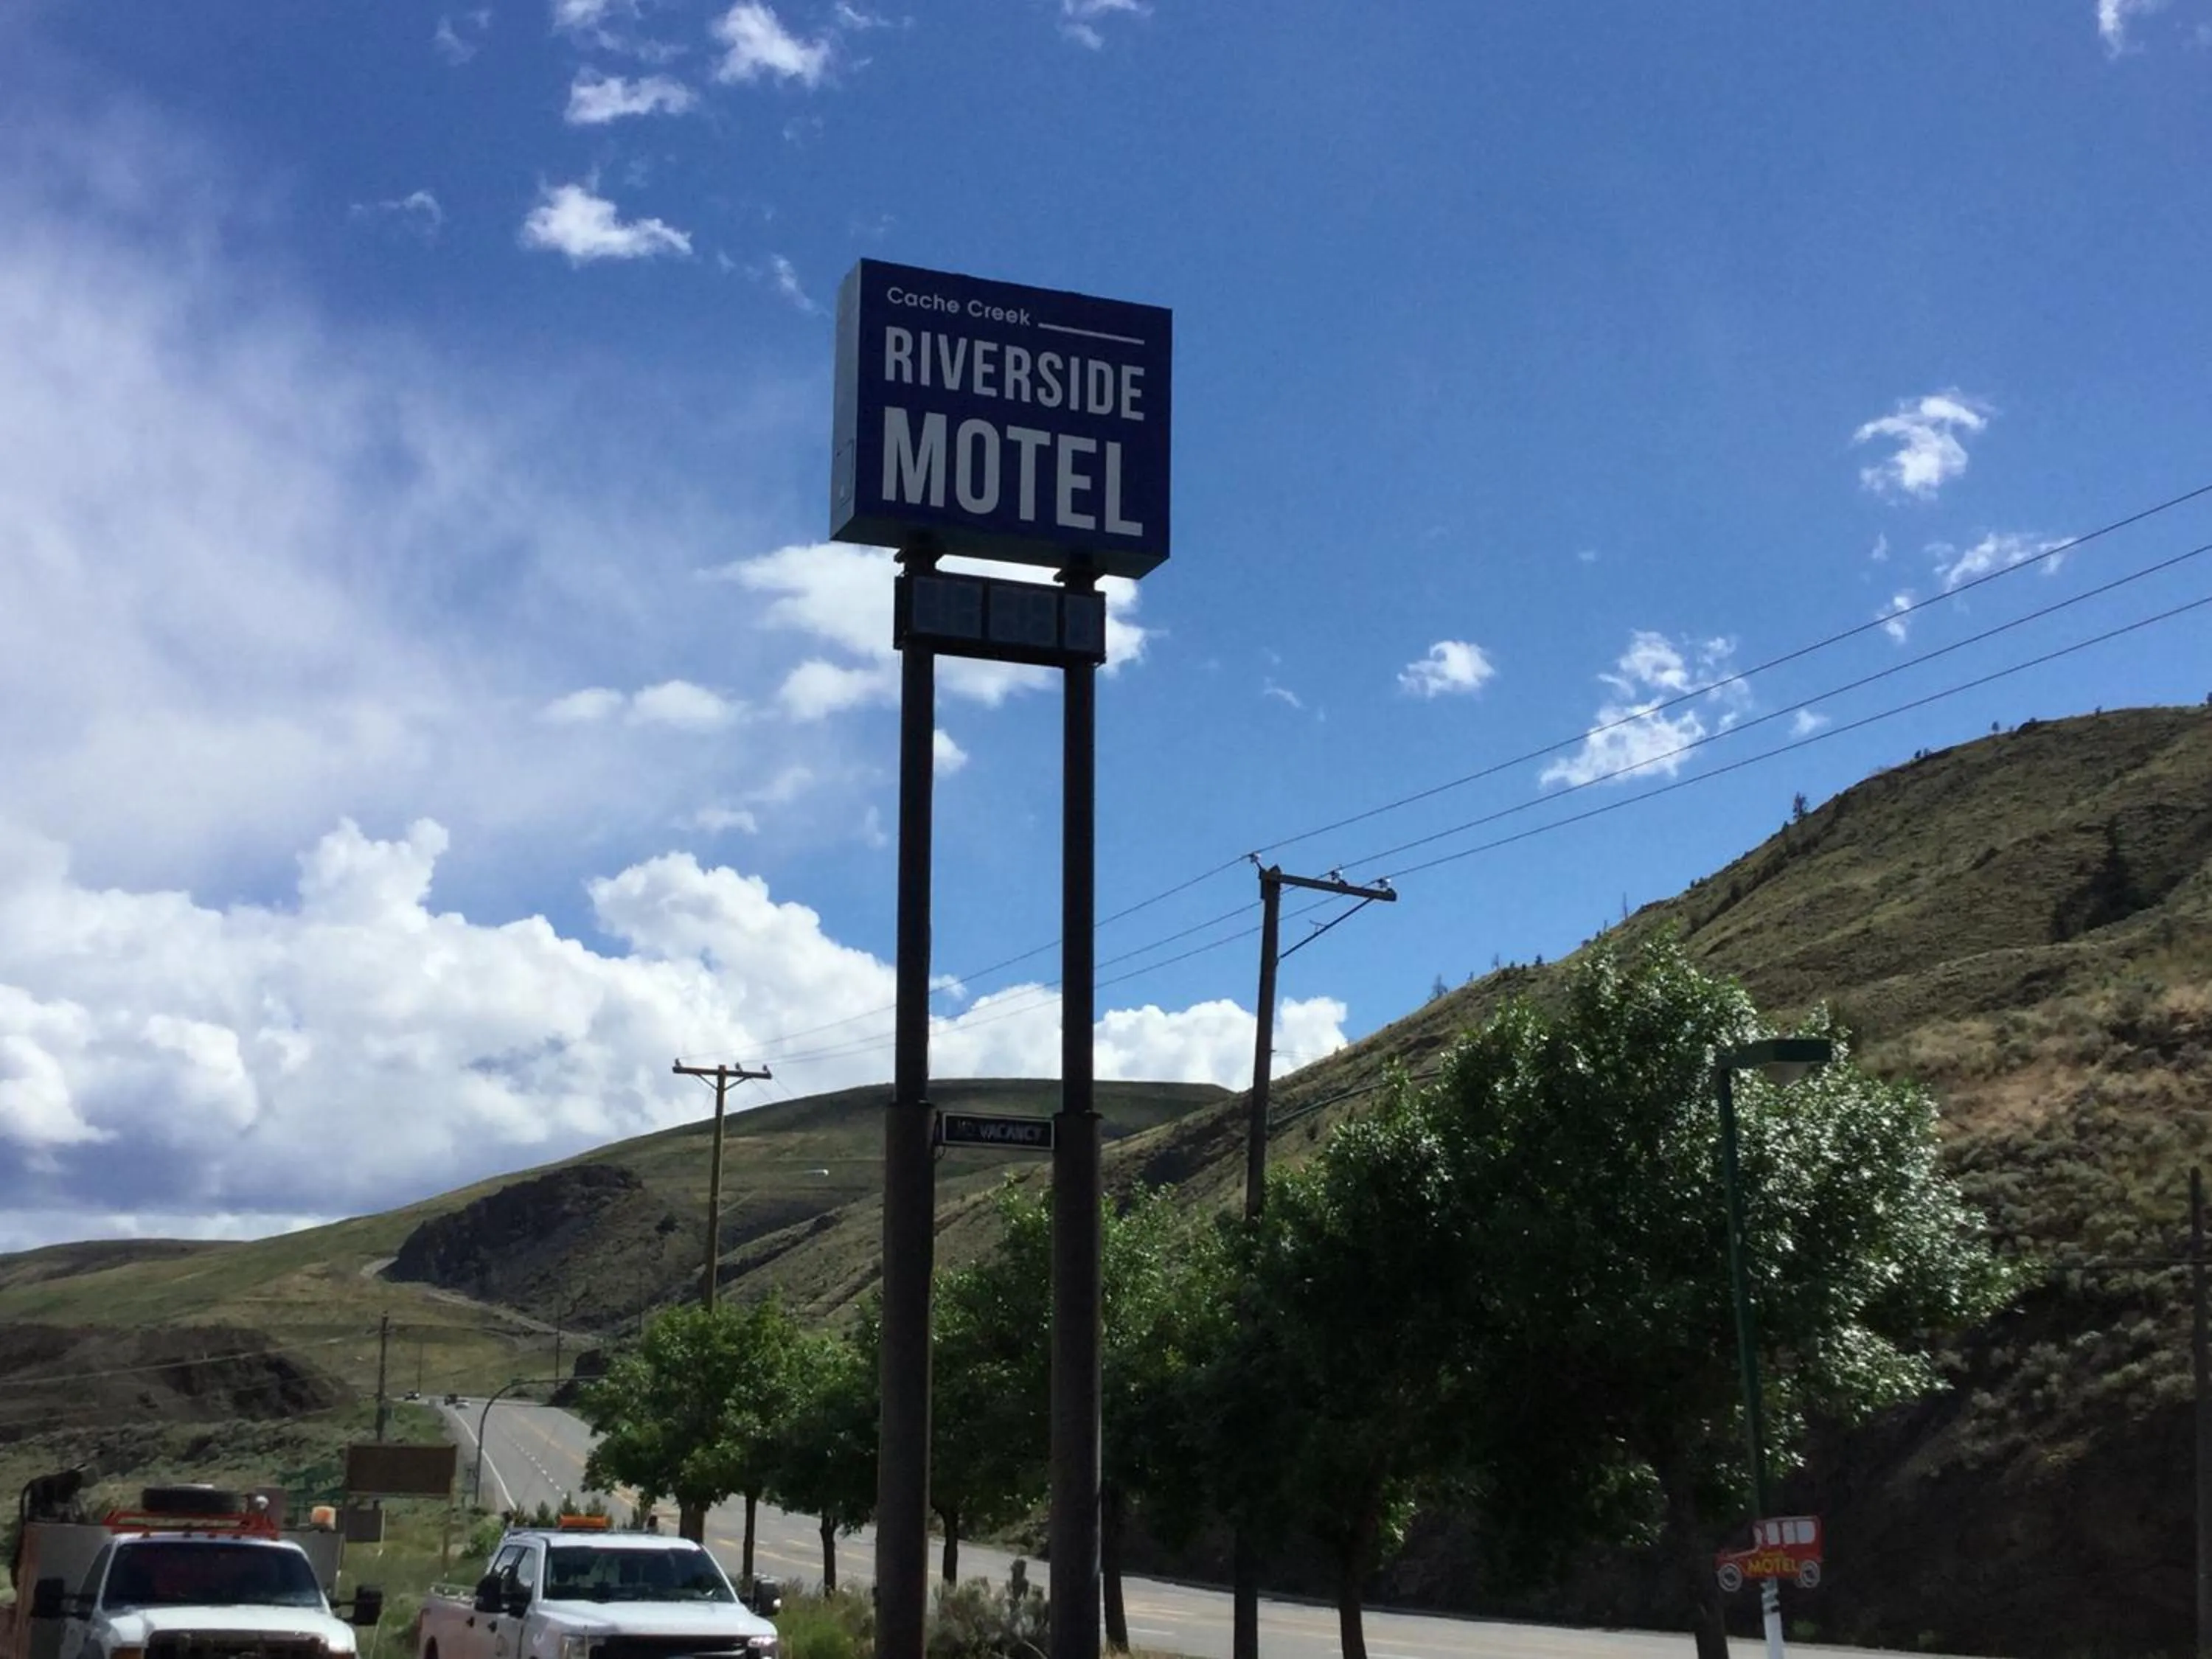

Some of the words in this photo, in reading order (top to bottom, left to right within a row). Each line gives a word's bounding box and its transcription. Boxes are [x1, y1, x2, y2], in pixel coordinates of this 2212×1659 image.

[887, 286, 959, 313] Cache
[967, 299, 1031, 326] Creek
[885, 326, 1144, 421] RIVERSIDE
[882, 406, 1143, 537] MOTEL
[979, 1122, 1041, 1141] VACANCY
[1747, 1557, 1798, 1573] MOTEL
